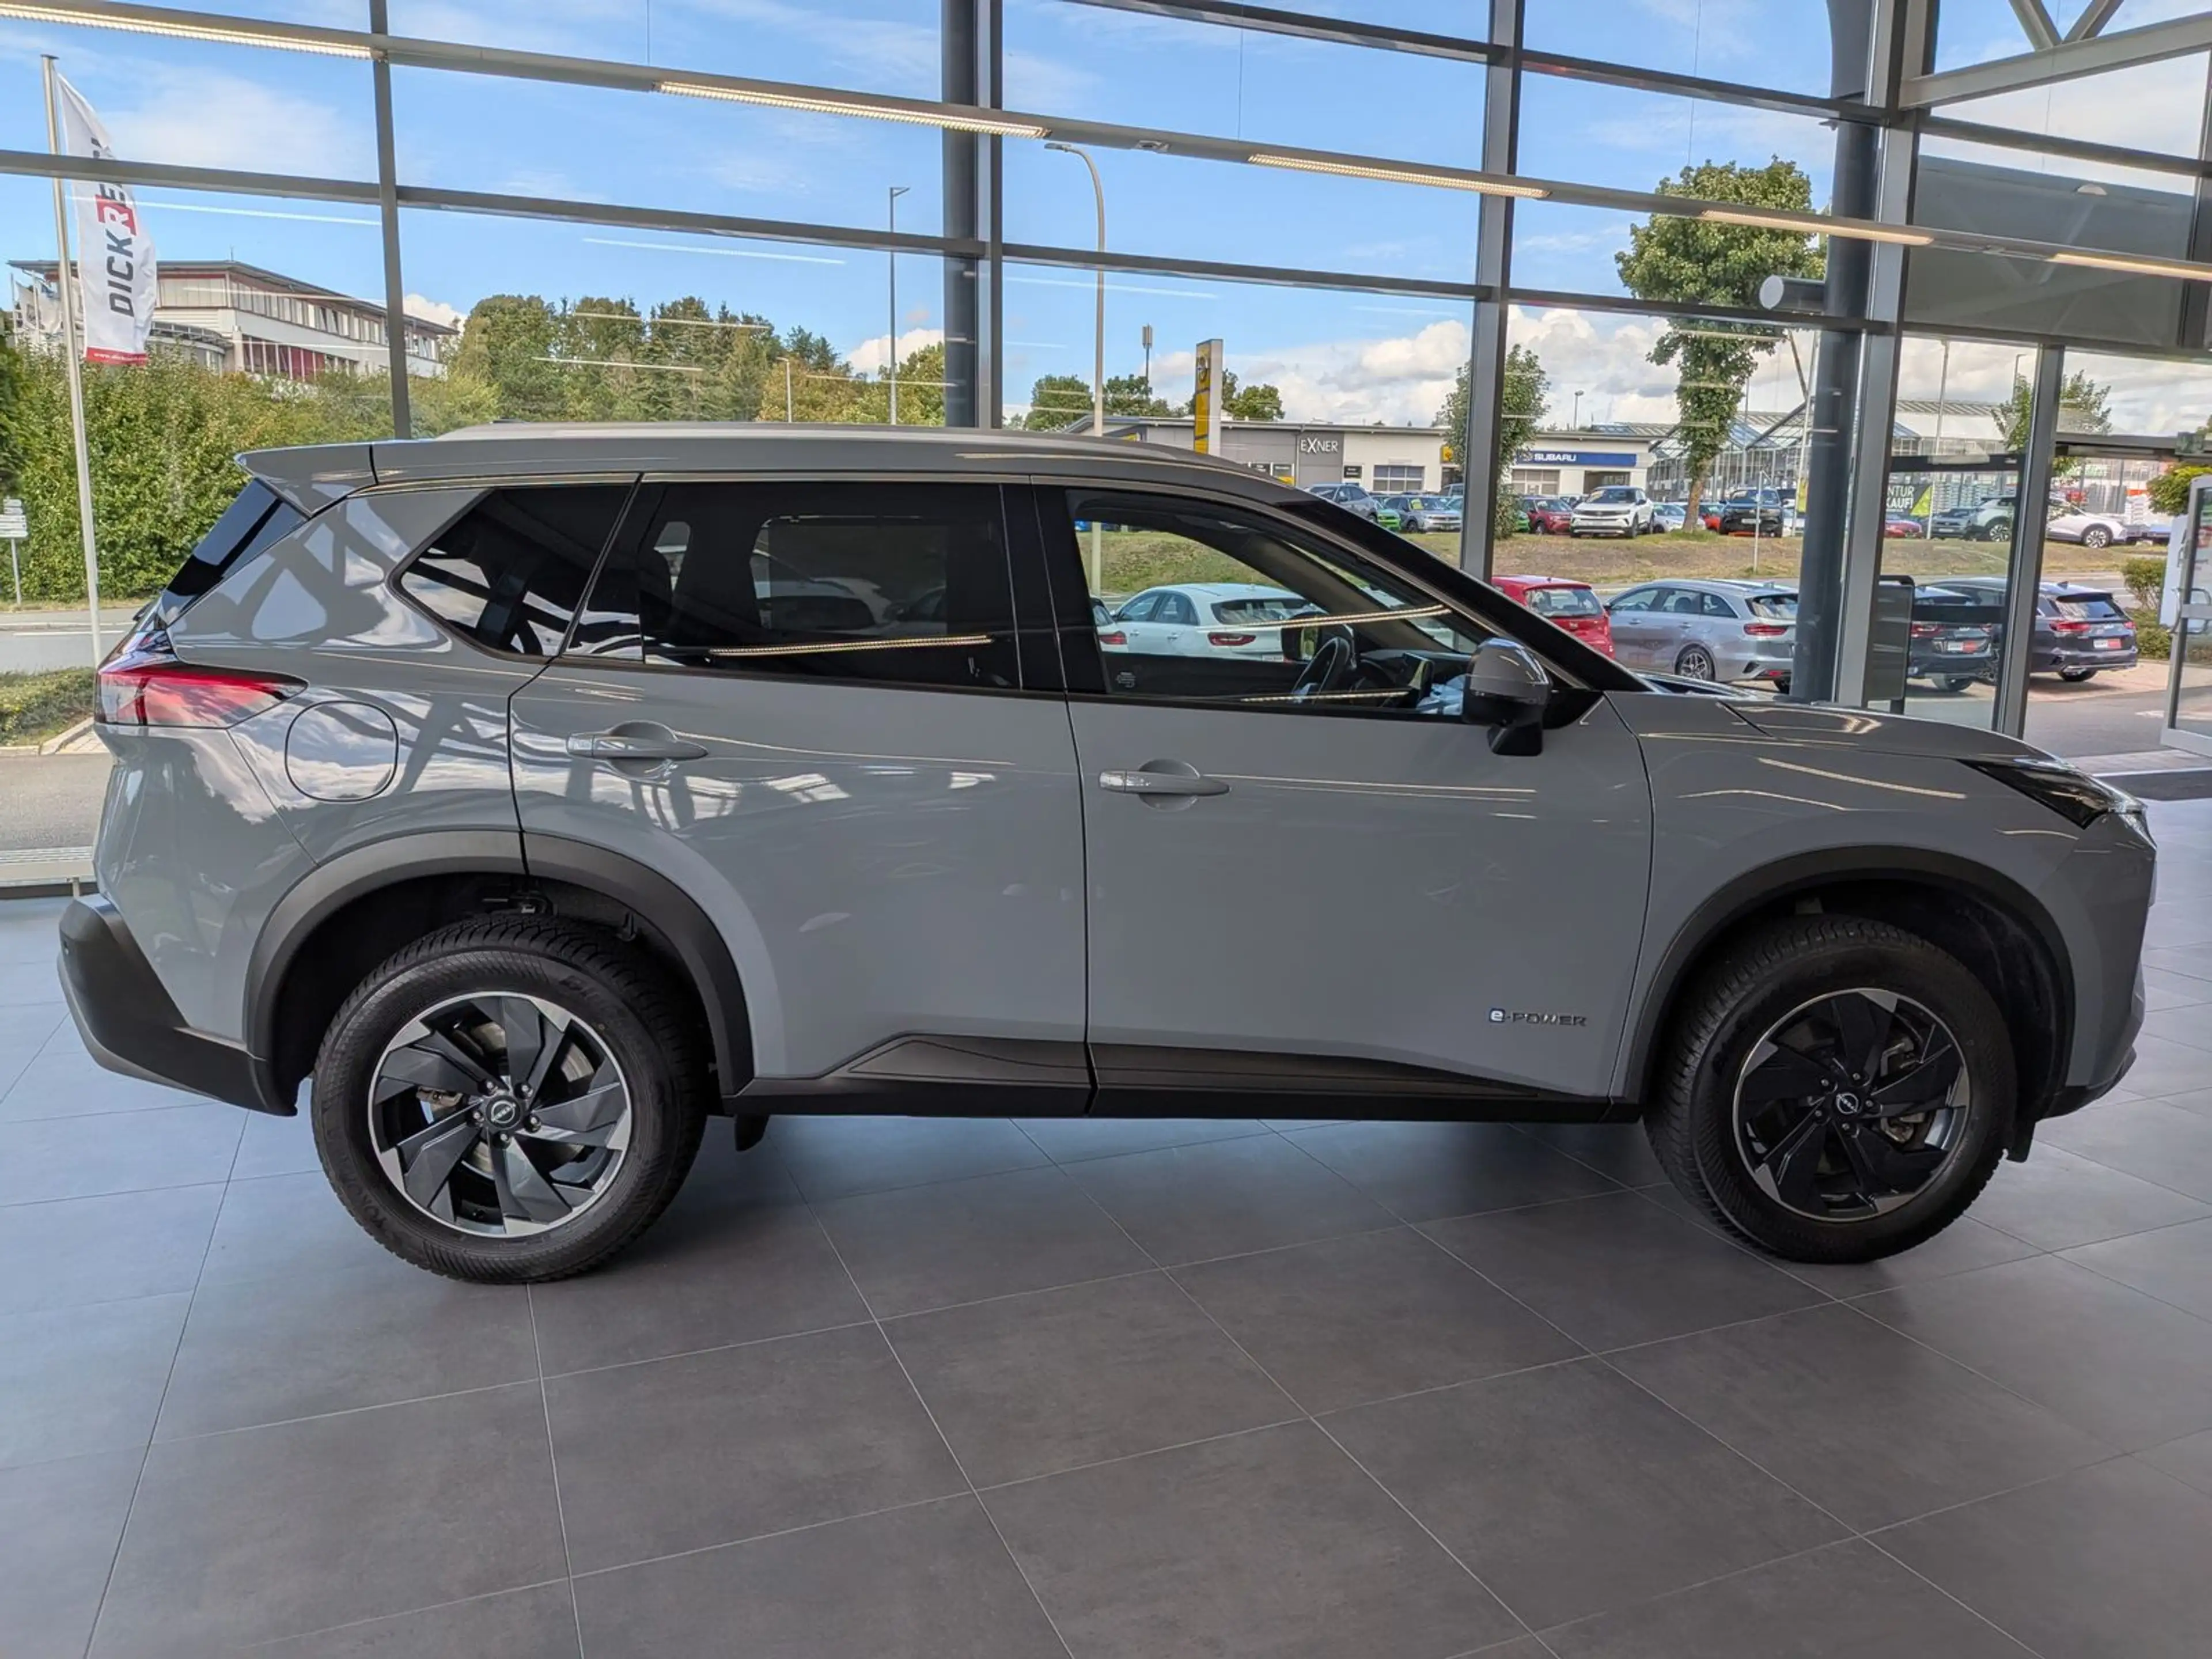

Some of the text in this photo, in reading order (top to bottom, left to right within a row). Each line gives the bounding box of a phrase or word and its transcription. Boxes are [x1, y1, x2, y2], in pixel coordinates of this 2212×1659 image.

[1300, 438, 1339, 454] EXNER
[1534, 453, 1577, 461] SUBARU
[1888, 485, 1914, 496] NTUR
[1490, 1009, 1587, 1026] e-POWER
